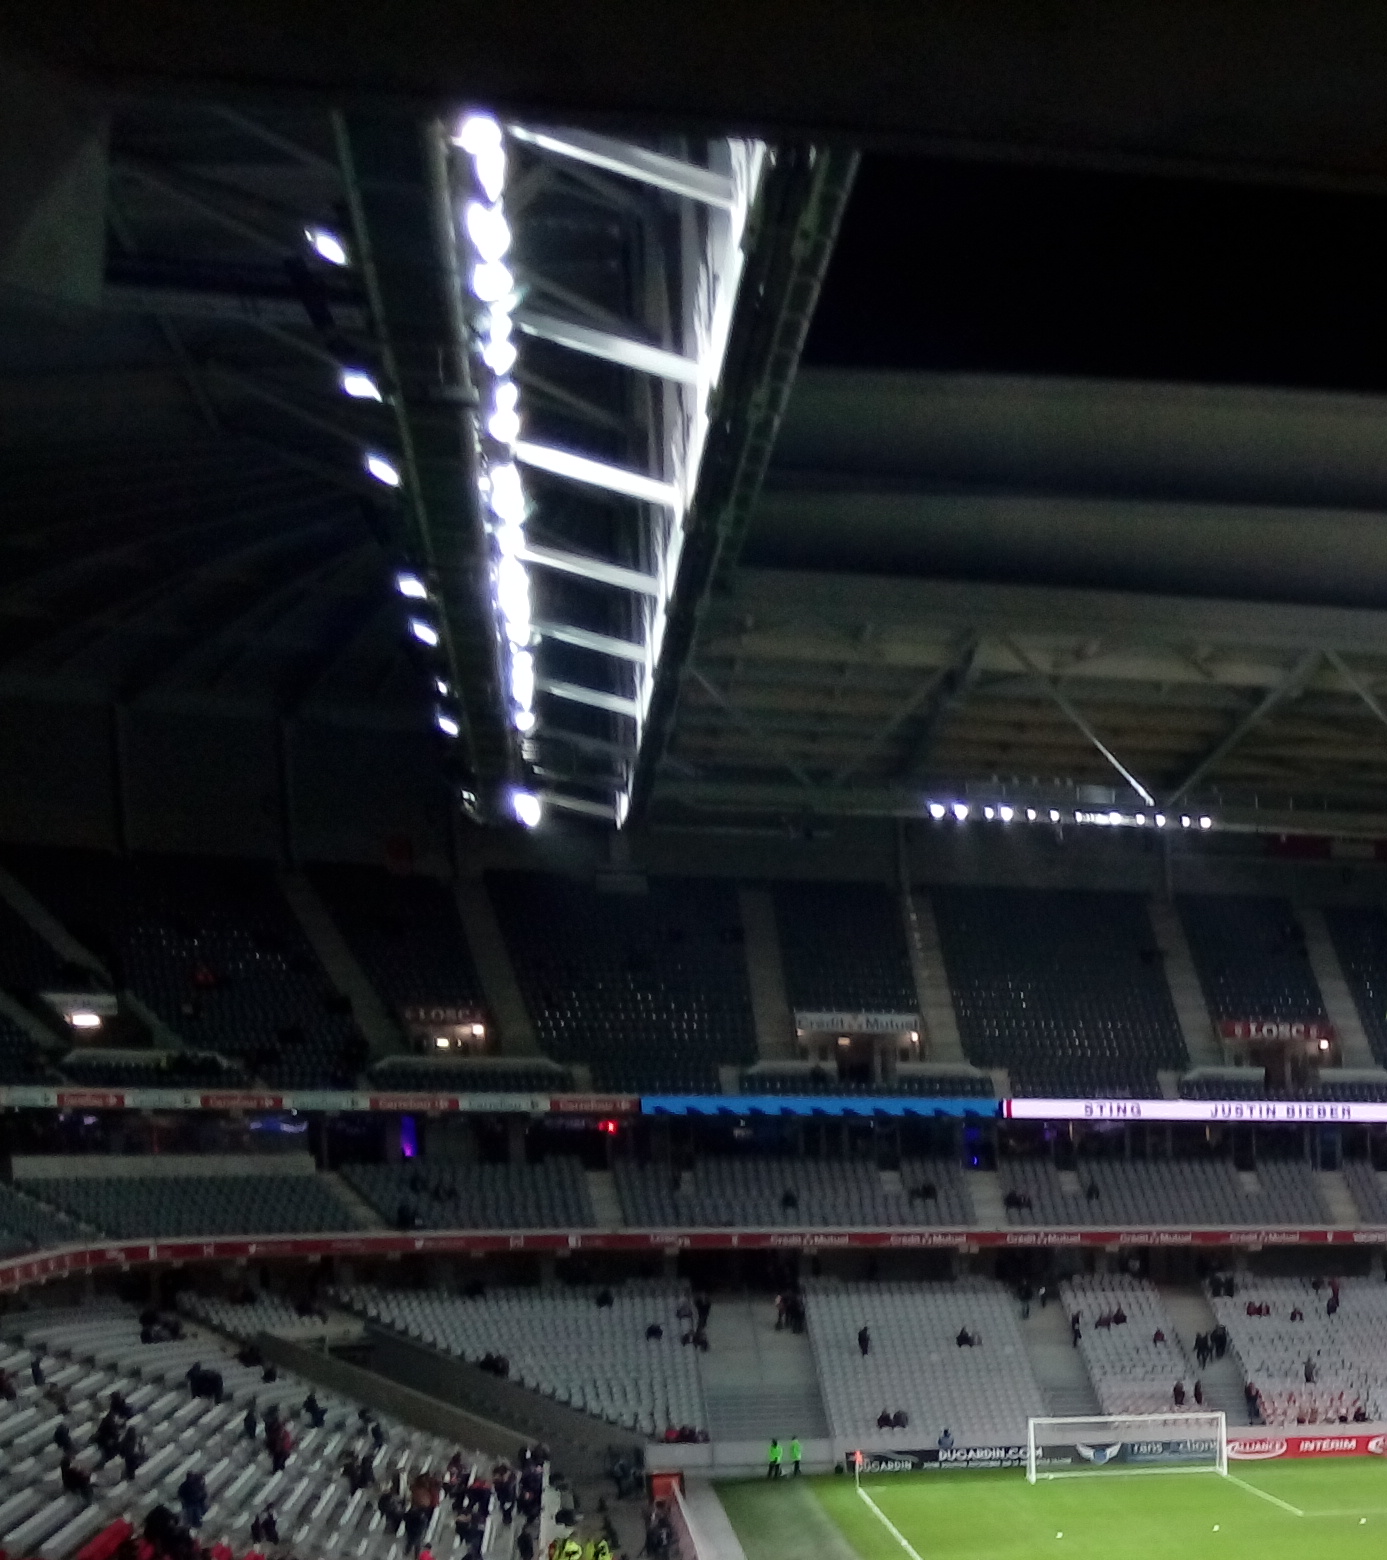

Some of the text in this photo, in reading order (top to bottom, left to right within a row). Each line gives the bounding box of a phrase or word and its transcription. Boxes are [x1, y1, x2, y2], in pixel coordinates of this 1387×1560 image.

[1084, 1103, 1142, 1118] STING
[1210, 1103, 1277, 1119] JUSTIN
[1286, 1104, 1352, 1120] BIEBER
